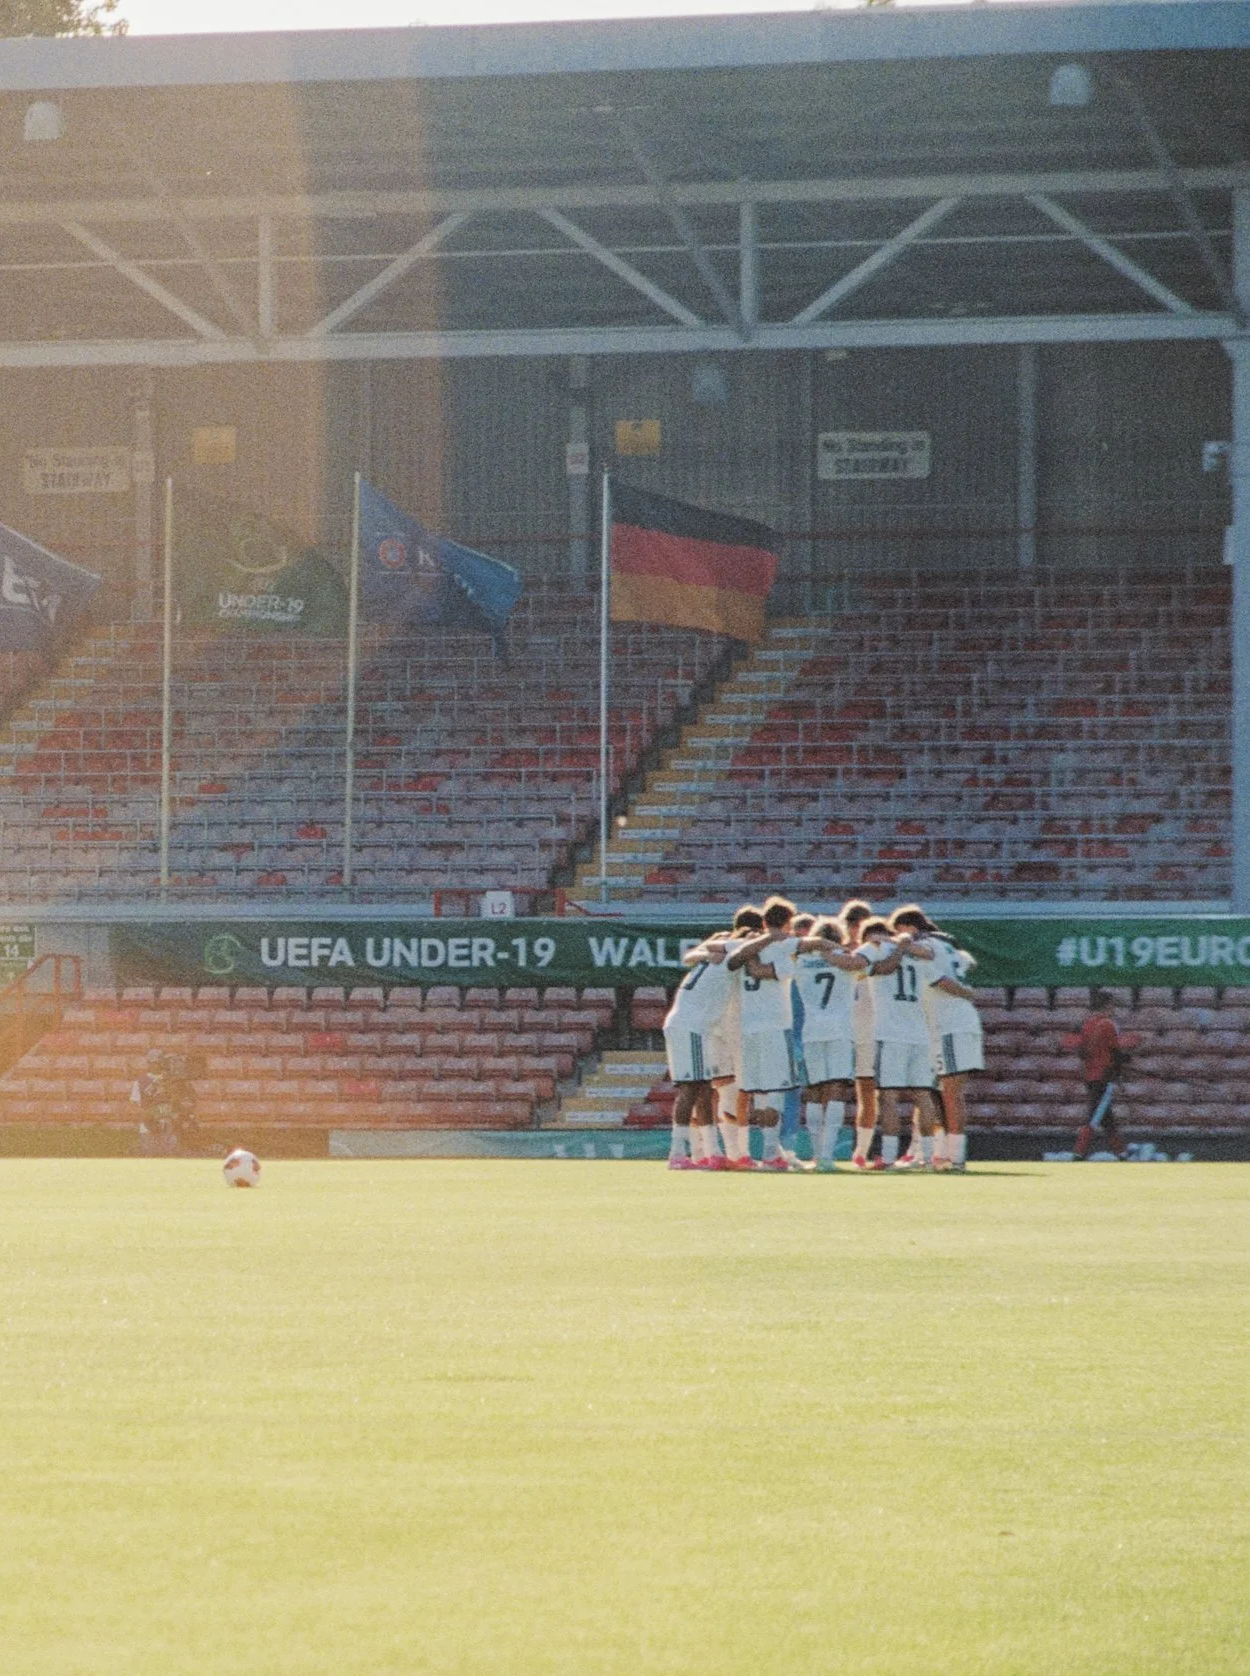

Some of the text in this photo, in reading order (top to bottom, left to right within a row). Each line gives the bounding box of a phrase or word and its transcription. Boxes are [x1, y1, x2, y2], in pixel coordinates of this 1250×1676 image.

[219, 592, 304, 613] UNDER-19
[491, 902, 507, 914] L2
[4, 943, 19, 957] 14
[261, 937, 356, 967] UEFA
[366, 937, 556, 968] UNDER-19
[815, 972, 836, 1009] 7
[893, 964, 918, 1002] 11
